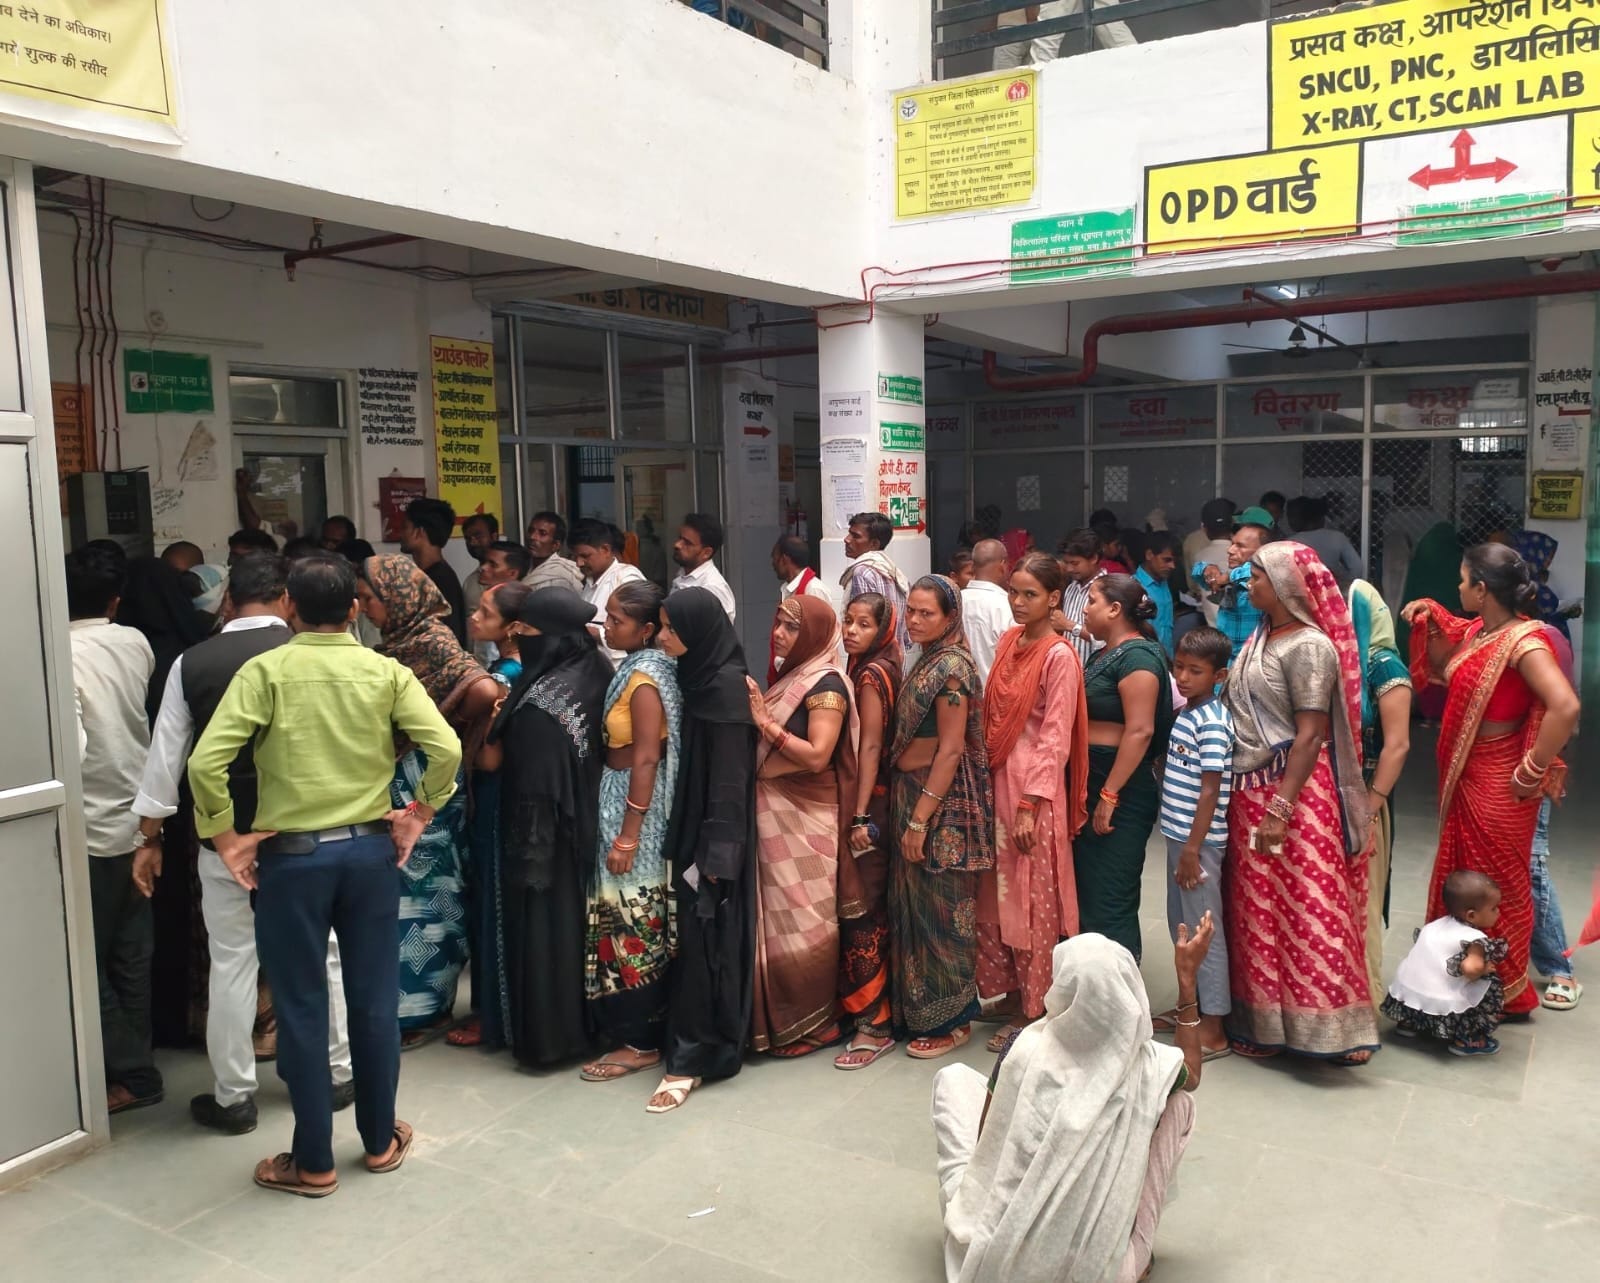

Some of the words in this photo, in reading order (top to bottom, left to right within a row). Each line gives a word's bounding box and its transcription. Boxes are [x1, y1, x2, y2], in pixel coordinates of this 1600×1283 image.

[17, 5, 39, 23] देने
[43, 14, 61, 28] का
[1289, 30, 1346, 61] प्रसव
[1300, 65, 1380, 100] SNCU,
[1391, 53, 1455, 83] PNC,
[1471, 17, 1600, 71] डायलिसि
[24, 47, 57, 64] शुल्क
[61, 53, 76, 69] की
[80, 60, 108, 77] रसीद
[1302, 103, 1382, 135] X-RAY,
[1517, 70, 1585, 105] LAB
[1160, 185, 1239, 225] OPD
[1246, 158, 1321, 214] वार्ड
[1129, 397, 1166, 416] दवा
[1251, 387, 1342, 416] वितरण
